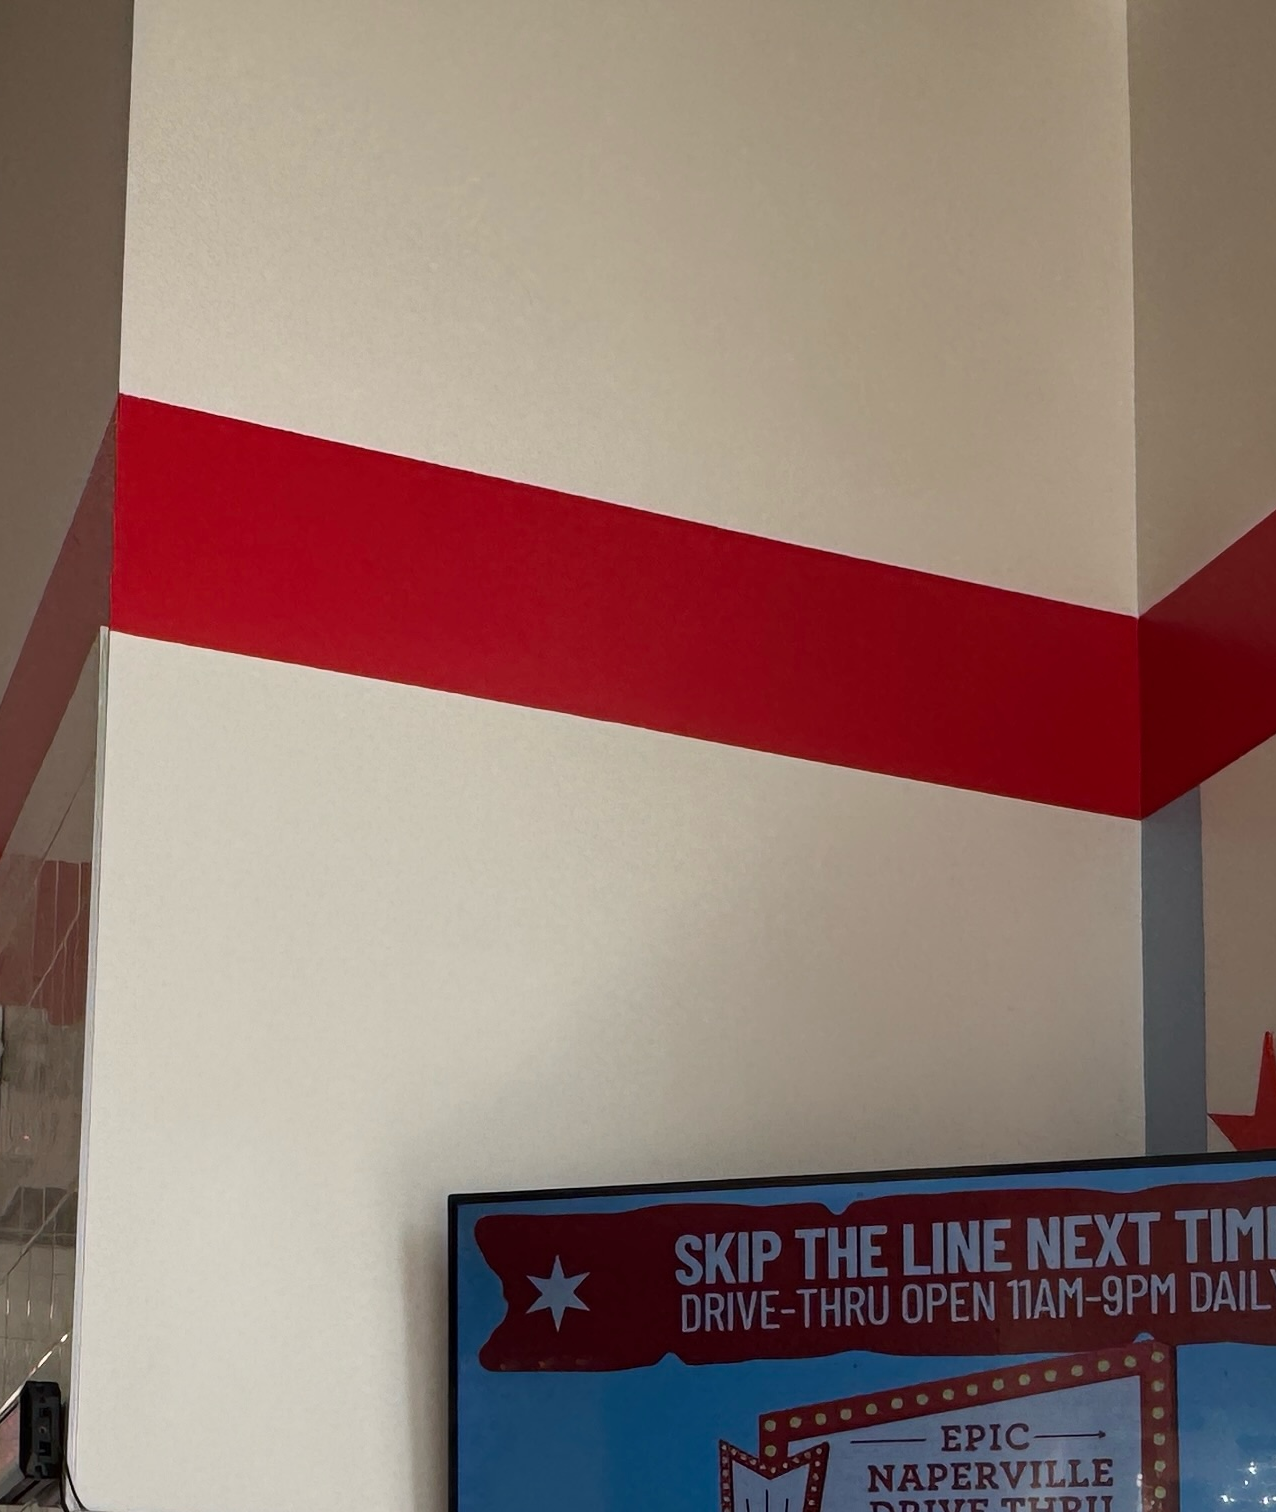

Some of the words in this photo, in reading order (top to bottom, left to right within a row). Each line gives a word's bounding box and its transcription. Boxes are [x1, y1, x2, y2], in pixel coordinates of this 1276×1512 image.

[674, 1231, 782, 1286] SKIP
[795, 1225, 888, 1280] THE
[903, 1218, 1012, 1276] LINE
[1027, 1212, 1161, 1271] NEXT
[681, 1284, 888, 1333] DRIVE-THRU
[902, 1280, 995, 1324] OPEN
[1006, 1273, 1176, 1320] 11AM-9PM
[941, 1423, 1029, 1452] EPIC
[867, 1458, 1113, 1492] NAPERVILLE
